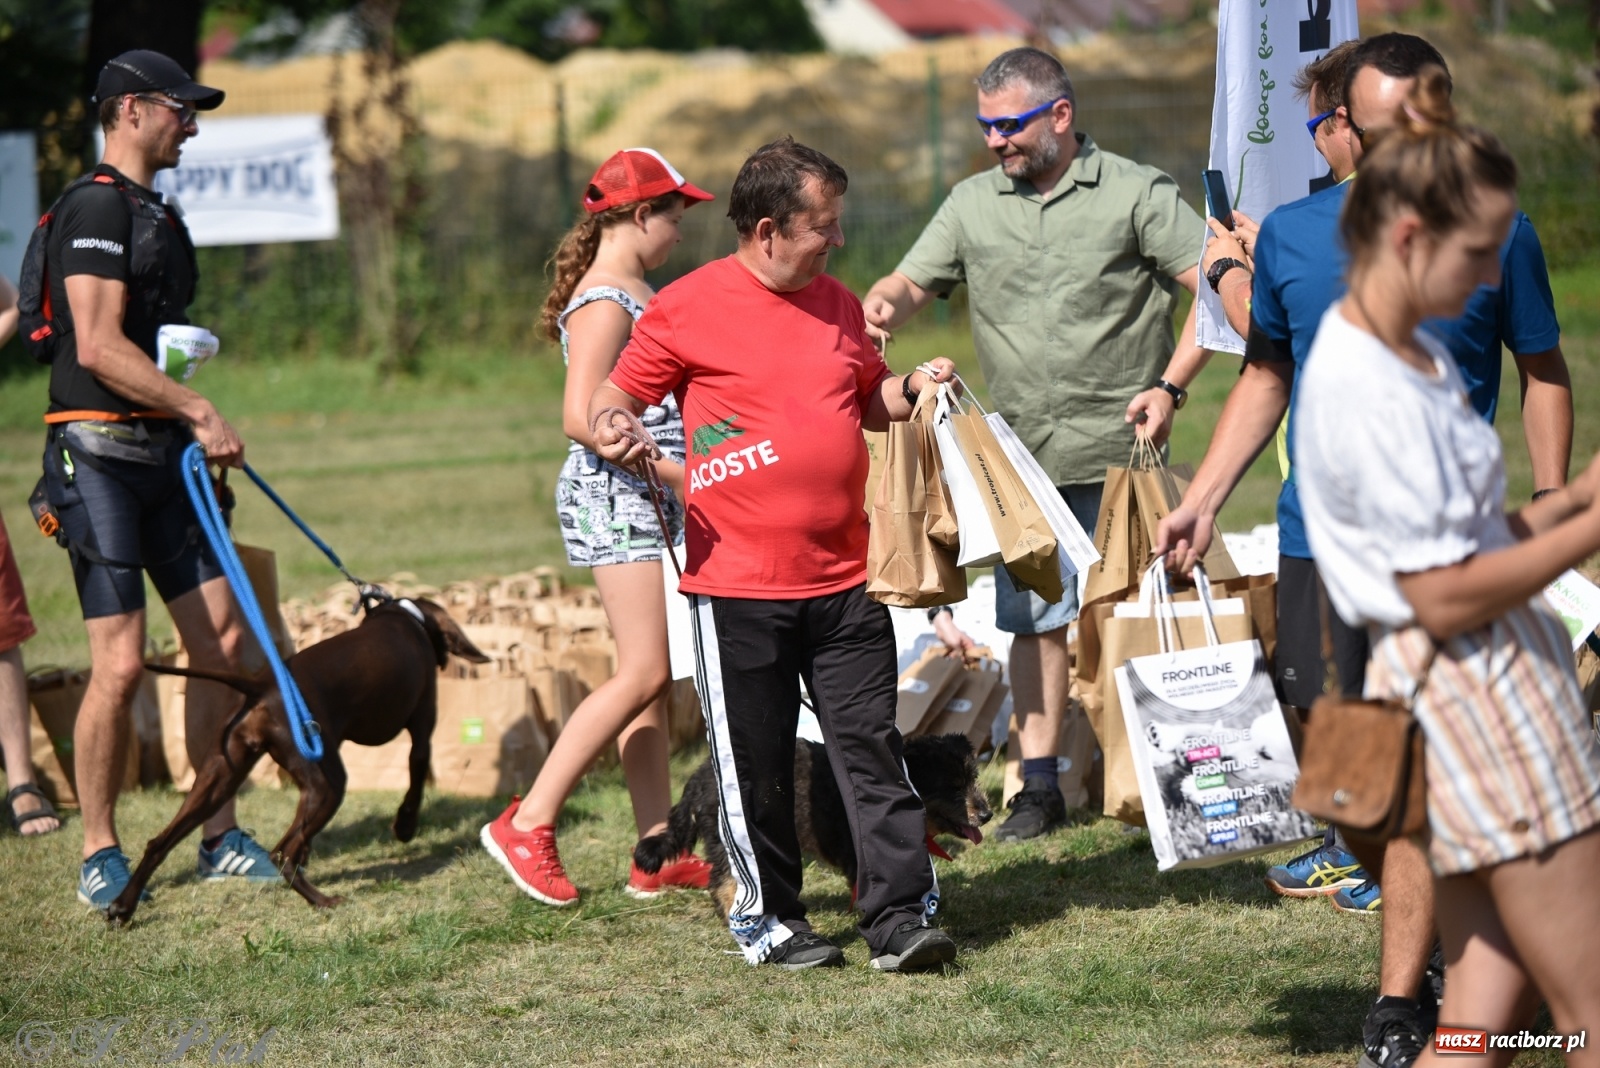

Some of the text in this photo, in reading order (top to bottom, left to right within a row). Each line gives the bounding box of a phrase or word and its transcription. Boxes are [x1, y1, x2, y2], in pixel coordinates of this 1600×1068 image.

[155, 152, 316, 197] APPY DOG
[72, 237, 125, 255] VISIONWEAR
[690, 439, 780, 494] ACOSTE
[585, 480, 607, 489] YOU
[975, 453, 1006, 518] www.tropicat.pl
[1099, 508, 1115, 573] www.tropicat.pl
[1162, 661, 1233, 683] FRONTLINE
[1185, 728, 1252, 749] FRONTLINE
[1192, 757, 1260, 777] FRONTLINE
[1200, 783, 1266, 805] FRONTLINE
[1206, 811, 1273, 833] FRONTLINE
[1210, 830, 1236, 843] SPRAY
